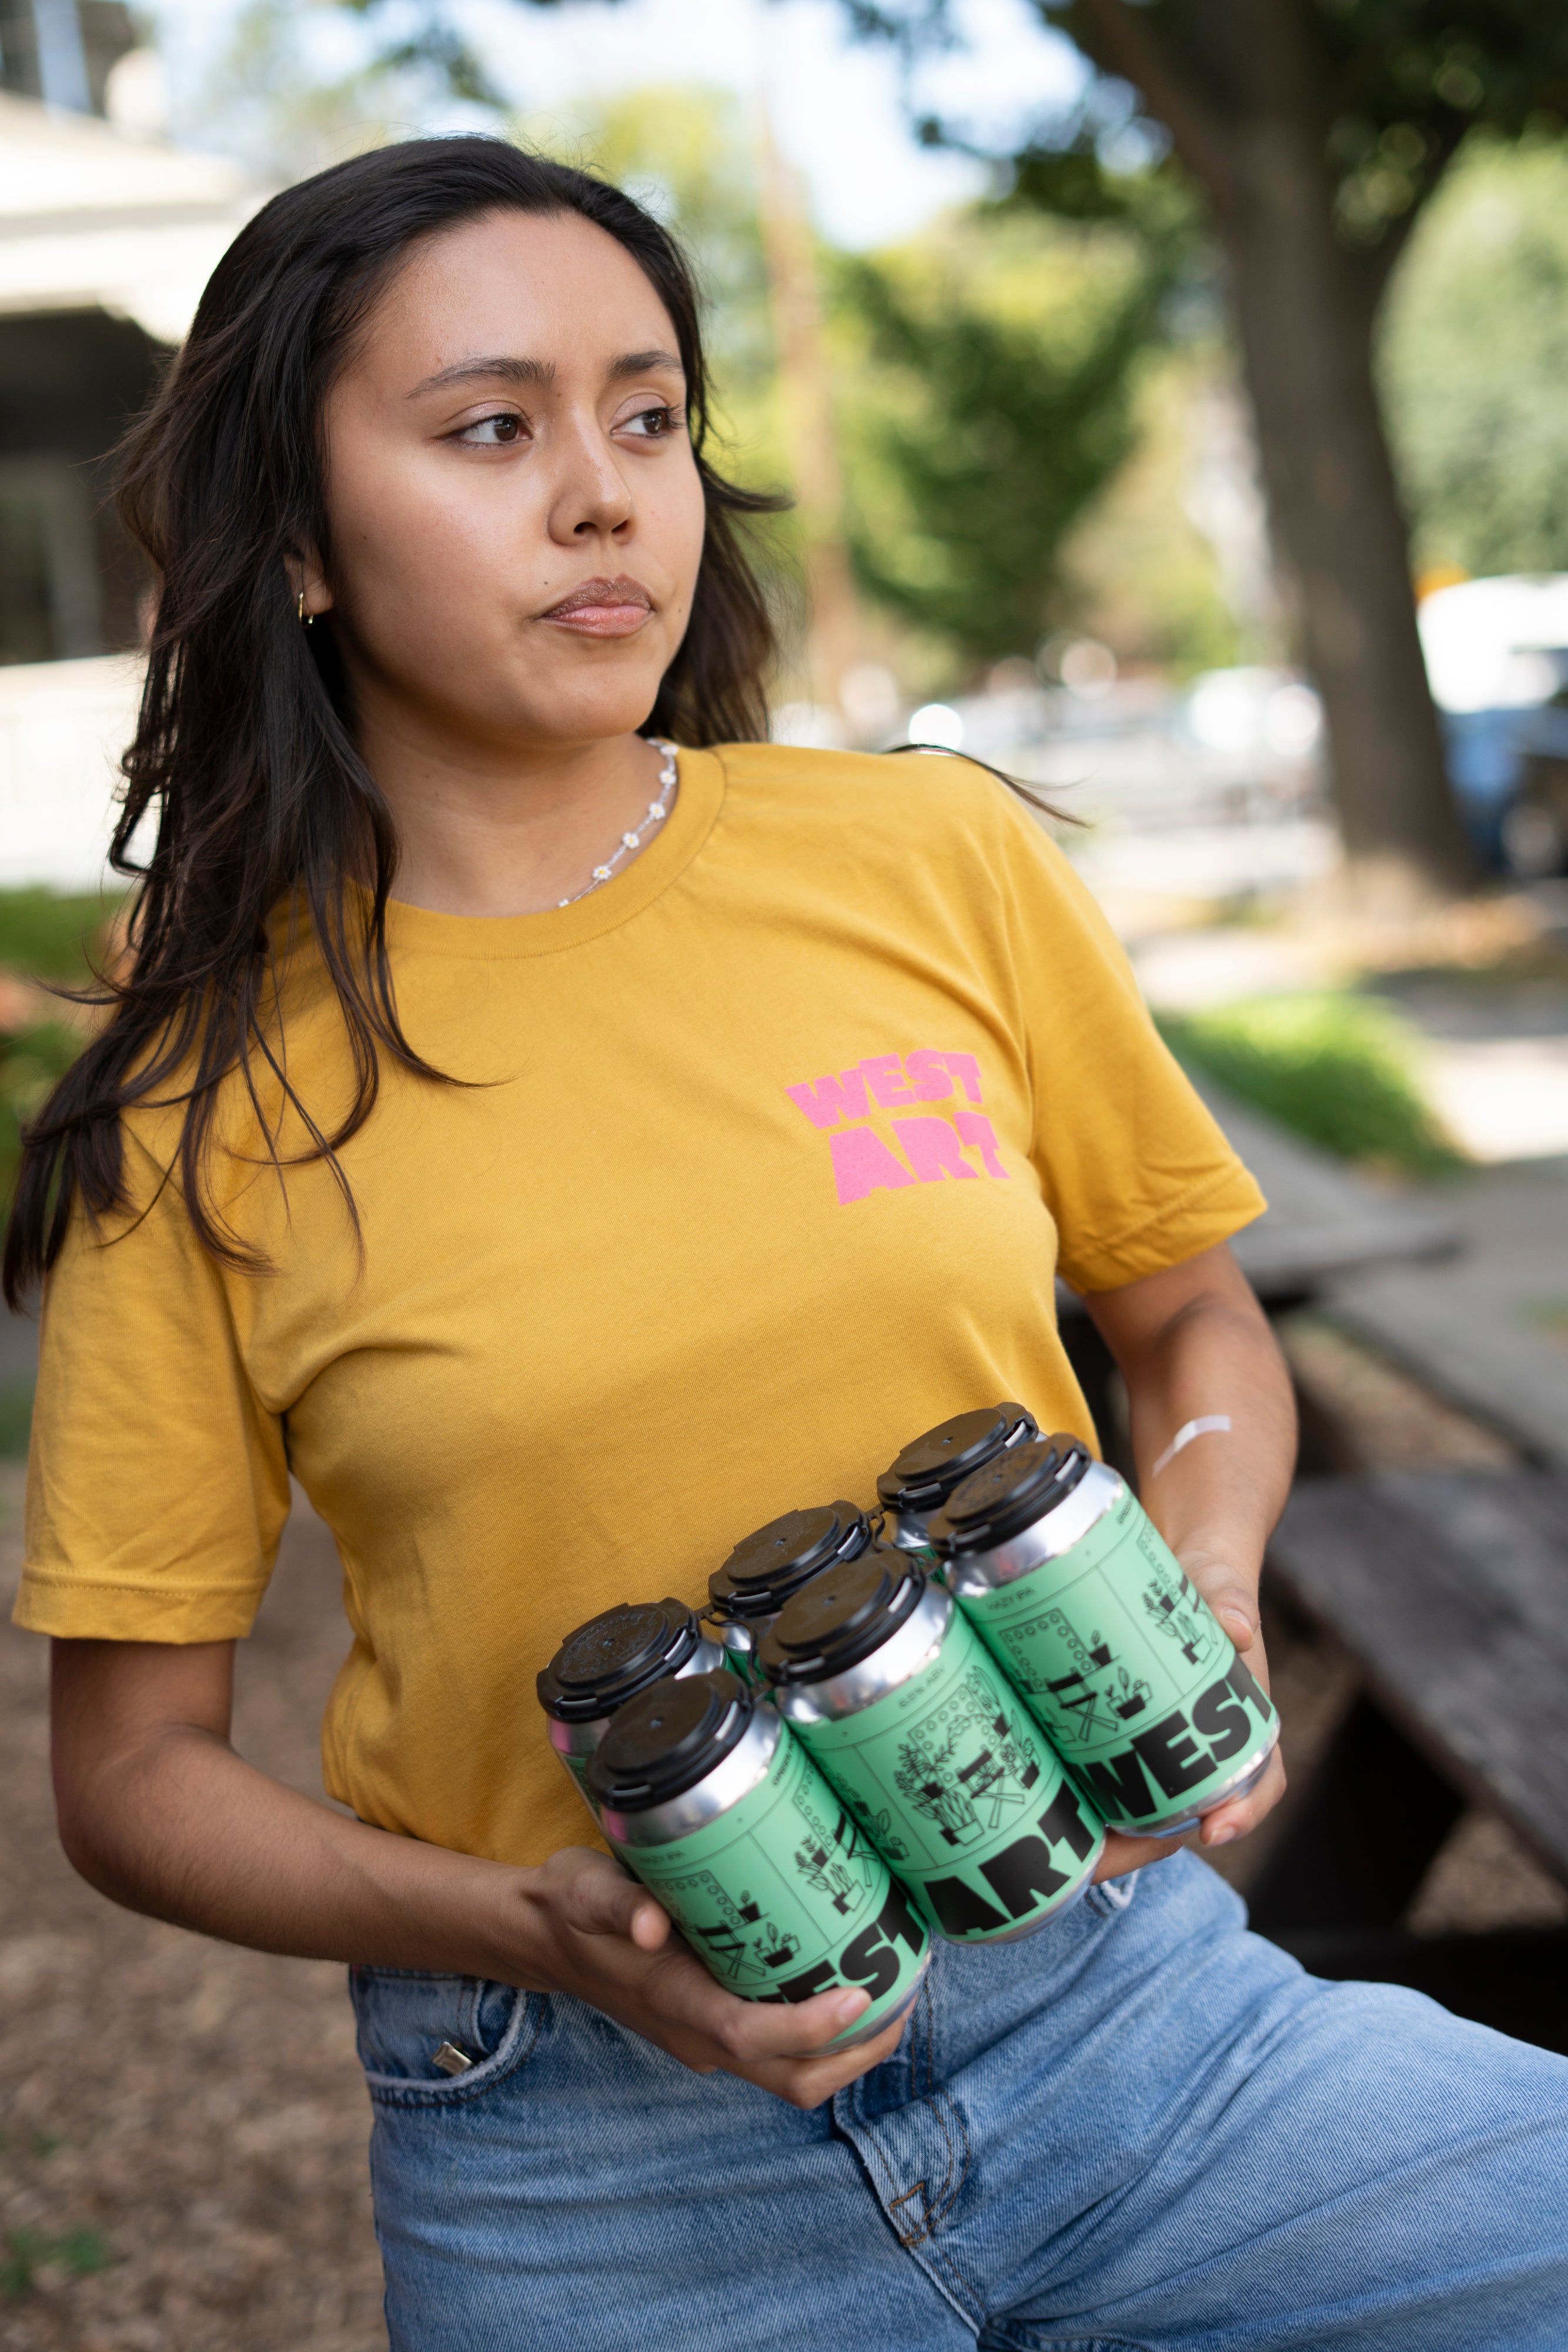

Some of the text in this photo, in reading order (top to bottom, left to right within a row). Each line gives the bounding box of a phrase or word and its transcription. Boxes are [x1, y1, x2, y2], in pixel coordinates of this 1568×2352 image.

[784, 1048, 982, 1130] WEST
[829, 1111, 1011, 1206] ART
[1067, 1653, 1272, 1820] WEST
[923, 1778, 1095, 1935] ART
[736, 1875, 925, 2004] ST
